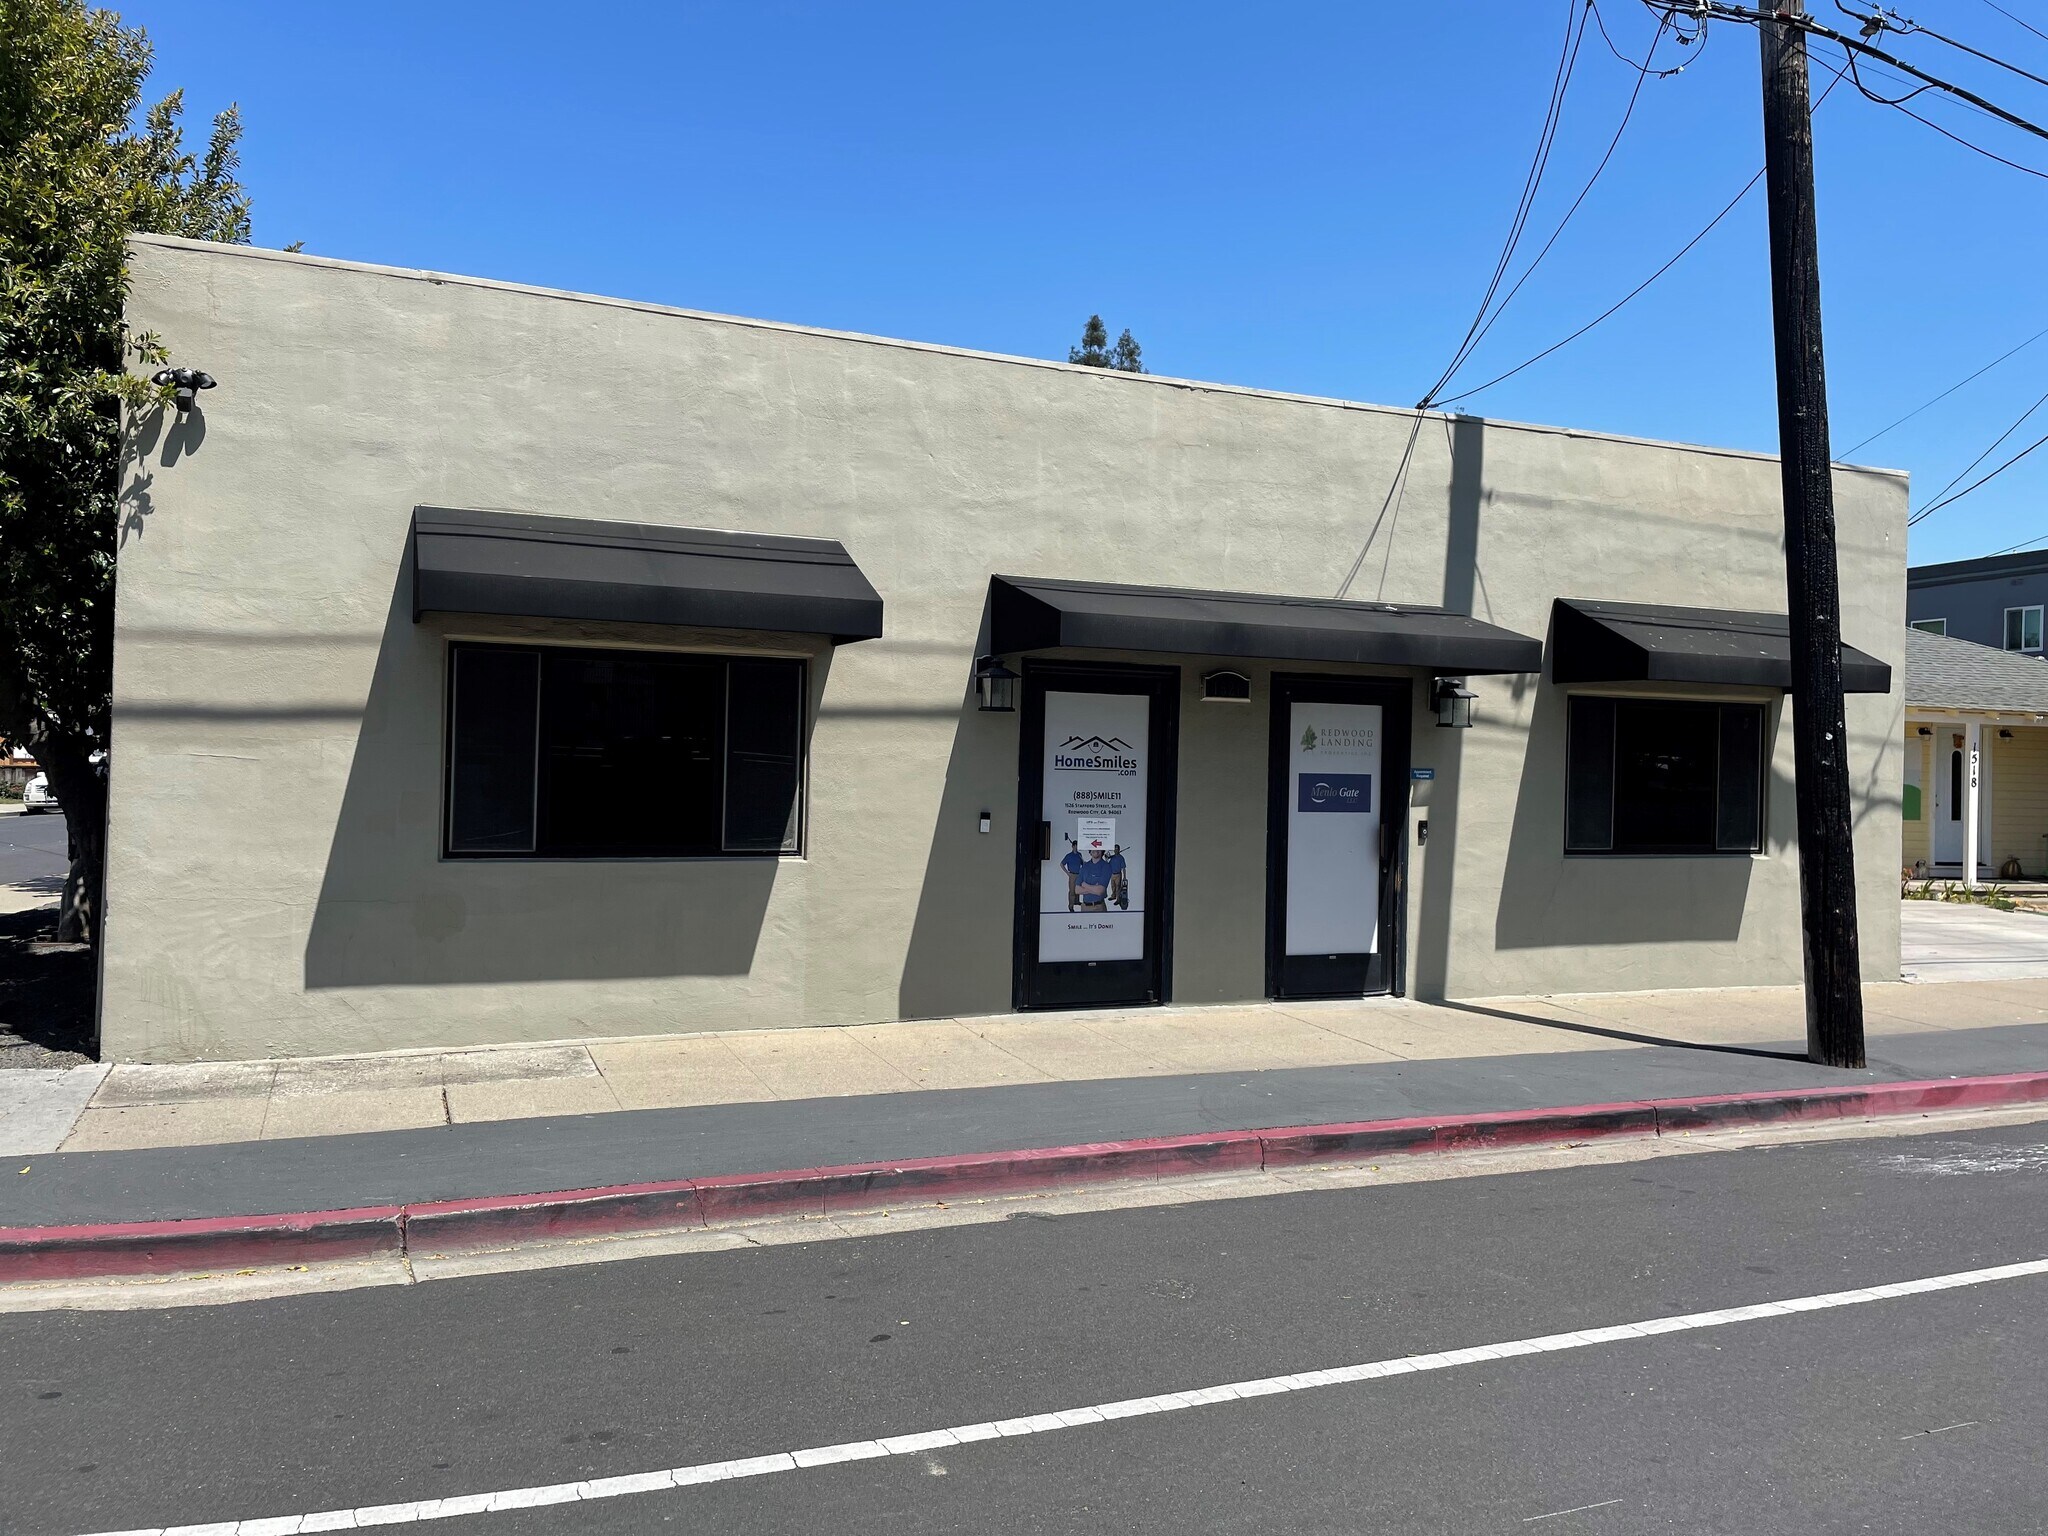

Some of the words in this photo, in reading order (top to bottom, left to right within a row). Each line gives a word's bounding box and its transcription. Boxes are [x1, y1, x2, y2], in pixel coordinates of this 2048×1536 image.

[1321, 728, 1374, 738] REDWOOD
[1321, 737, 1373, 747] LANDING
[1055, 755, 1137, 769] HomeSmiles
[1118, 769, 1137, 777] .com
[1073, 790, 1122, 801] (888)SMILE11
[1311, 787, 1338, 797] Menlo
[1339, 787, 1360, 797] Gate
